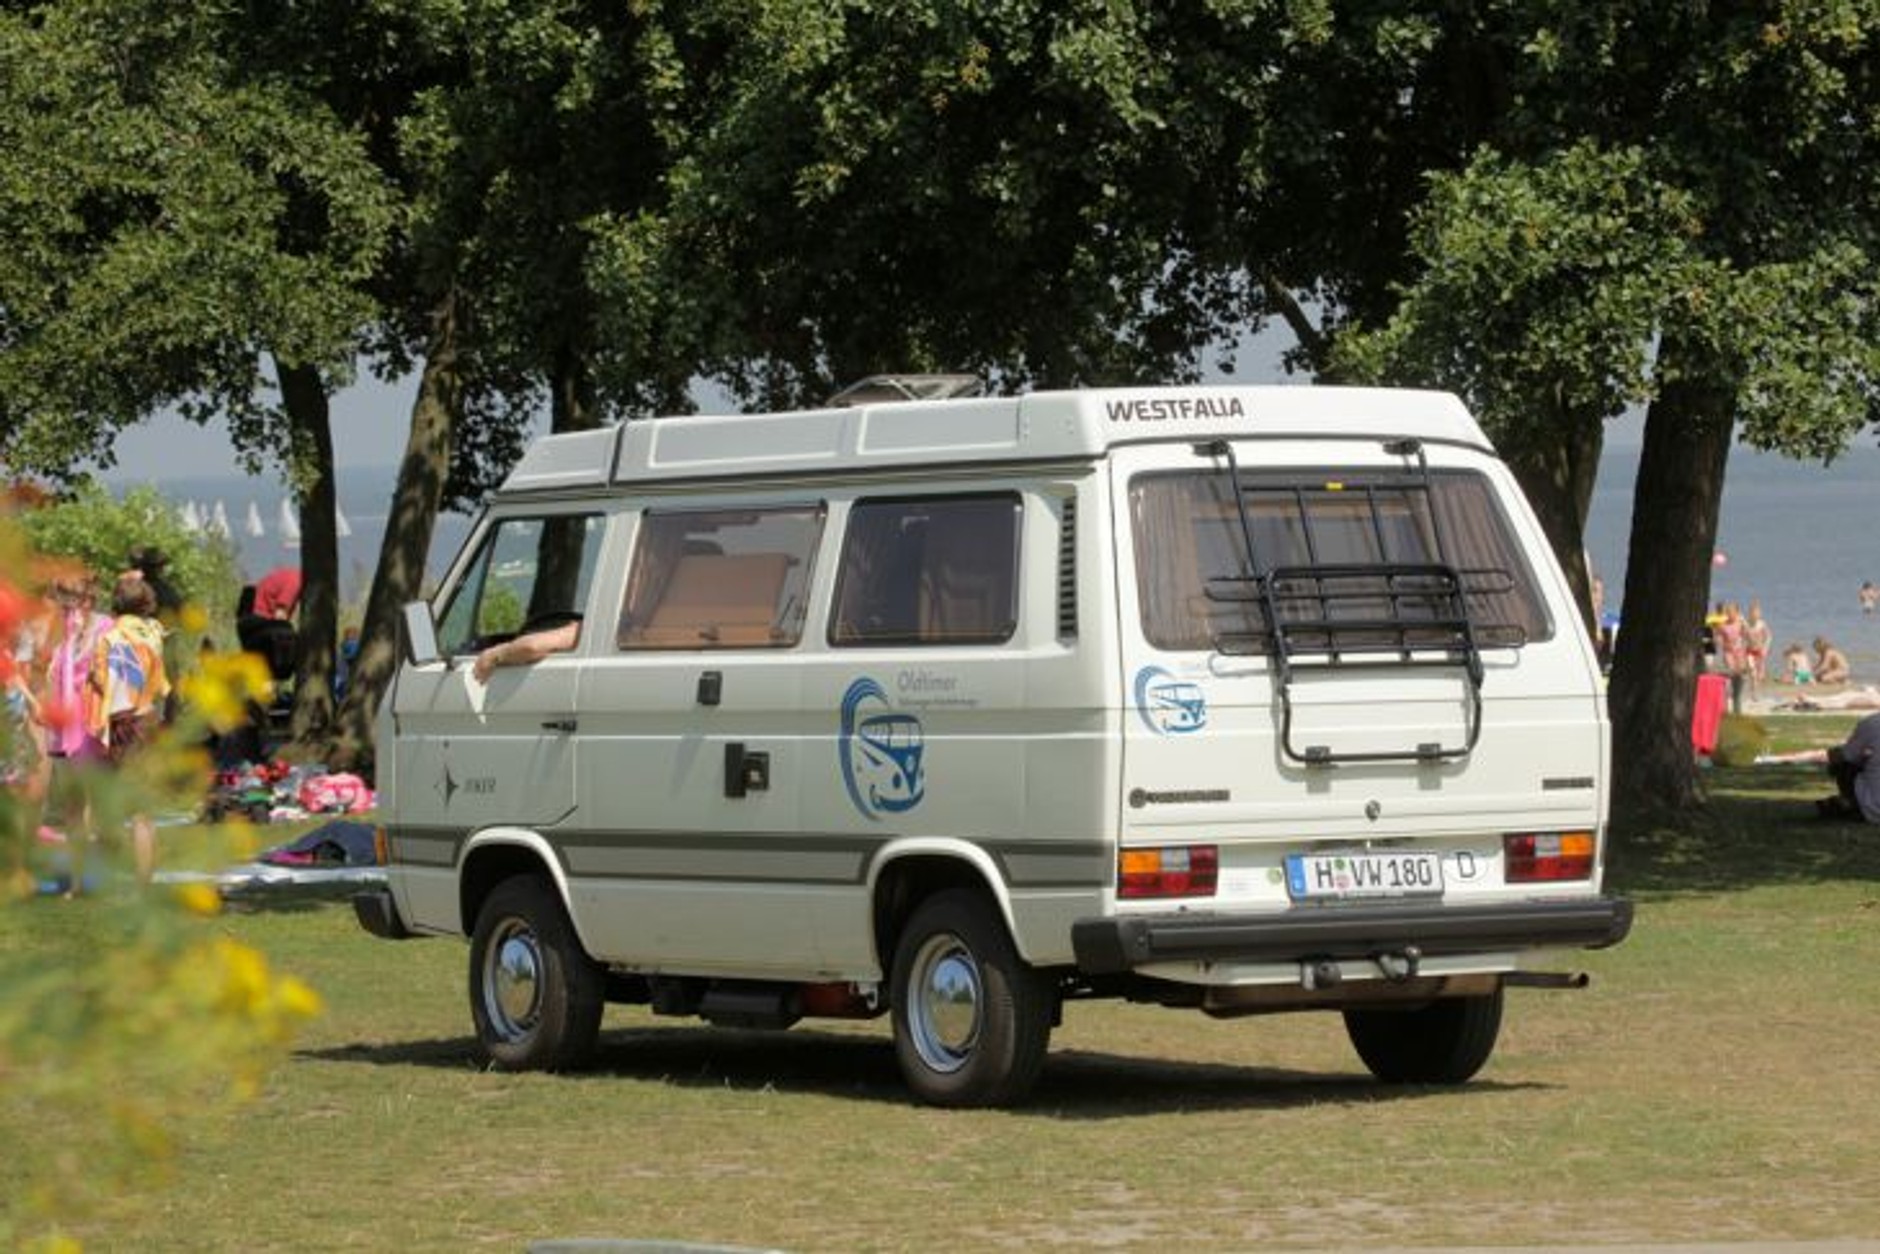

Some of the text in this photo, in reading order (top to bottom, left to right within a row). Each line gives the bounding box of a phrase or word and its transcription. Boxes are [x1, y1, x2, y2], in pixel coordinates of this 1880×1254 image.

[1106, 397, 1244, 421] WESTFALIA
[897, 670, 959, 692] Oldtimer
[1315, 858, 1432, 888] H VW 180
[1456, 852, 1476, 878] D
